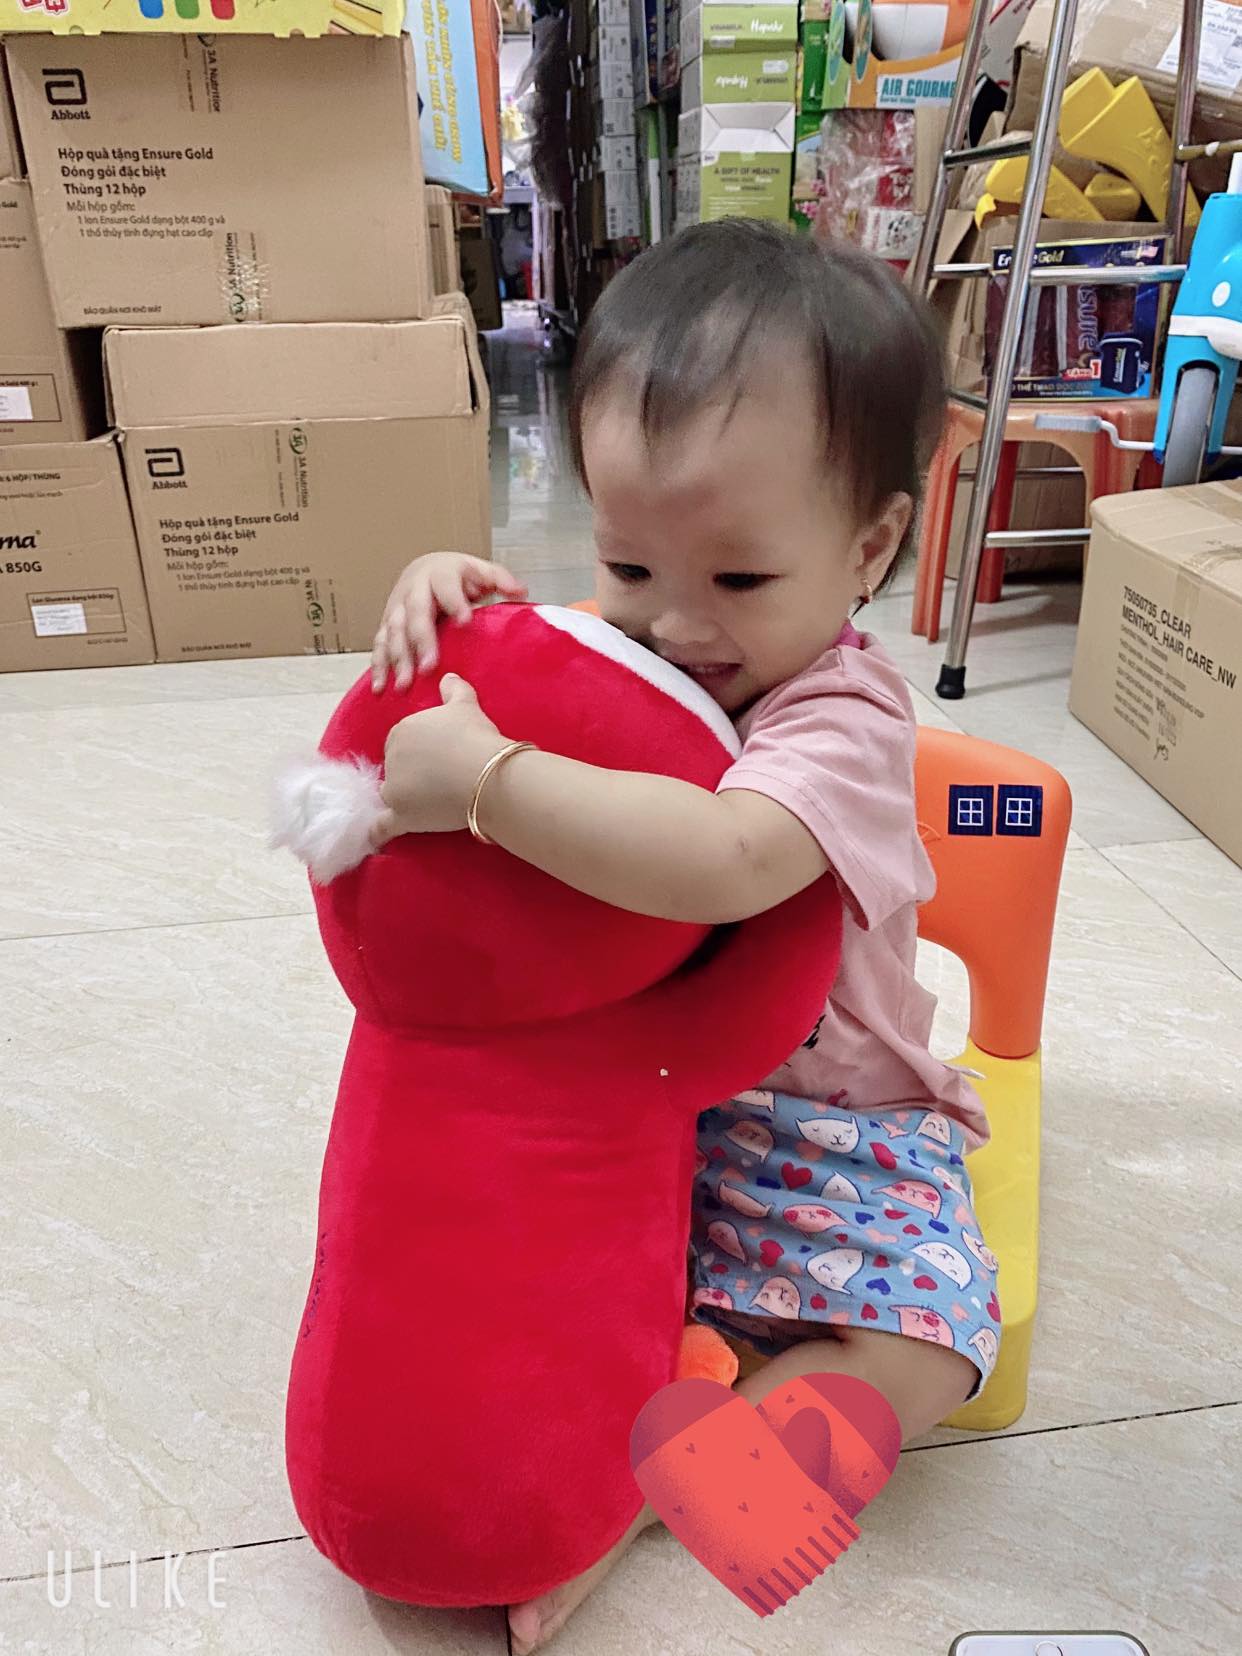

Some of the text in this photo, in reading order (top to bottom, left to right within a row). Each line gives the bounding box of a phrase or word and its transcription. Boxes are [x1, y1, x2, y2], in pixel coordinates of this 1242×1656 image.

[881, 78, 903, 96] AIR
[51, 109, 91, 120] Abbott
[58, 147, 213, 162] Hộp quà tặng Ensure Gold
[61, 165, 166, 180] Đóng gói đặc biệt
[63, 182, 146, 198] Thùng 12 hộp
[100, 215, 129, 224] Ensure
[129, 215, 150, 224] Gold
[1039, 250, 1064, 263] Gold
[152, 480, 187, 490] Abbott
[160, 512, 299, 531] Hộp quà tặng Ensure Gold
[162, 528, 256, 544] Đóng gói đặc biệt
[164, 544, 238, 559] Thùng 12 hộp
[6, 560, 42, 573] 850G
[1121, 604, 1185, 657] MENTHOL_HAIR
[1185, 645, 1238, 689] CARE_NW
